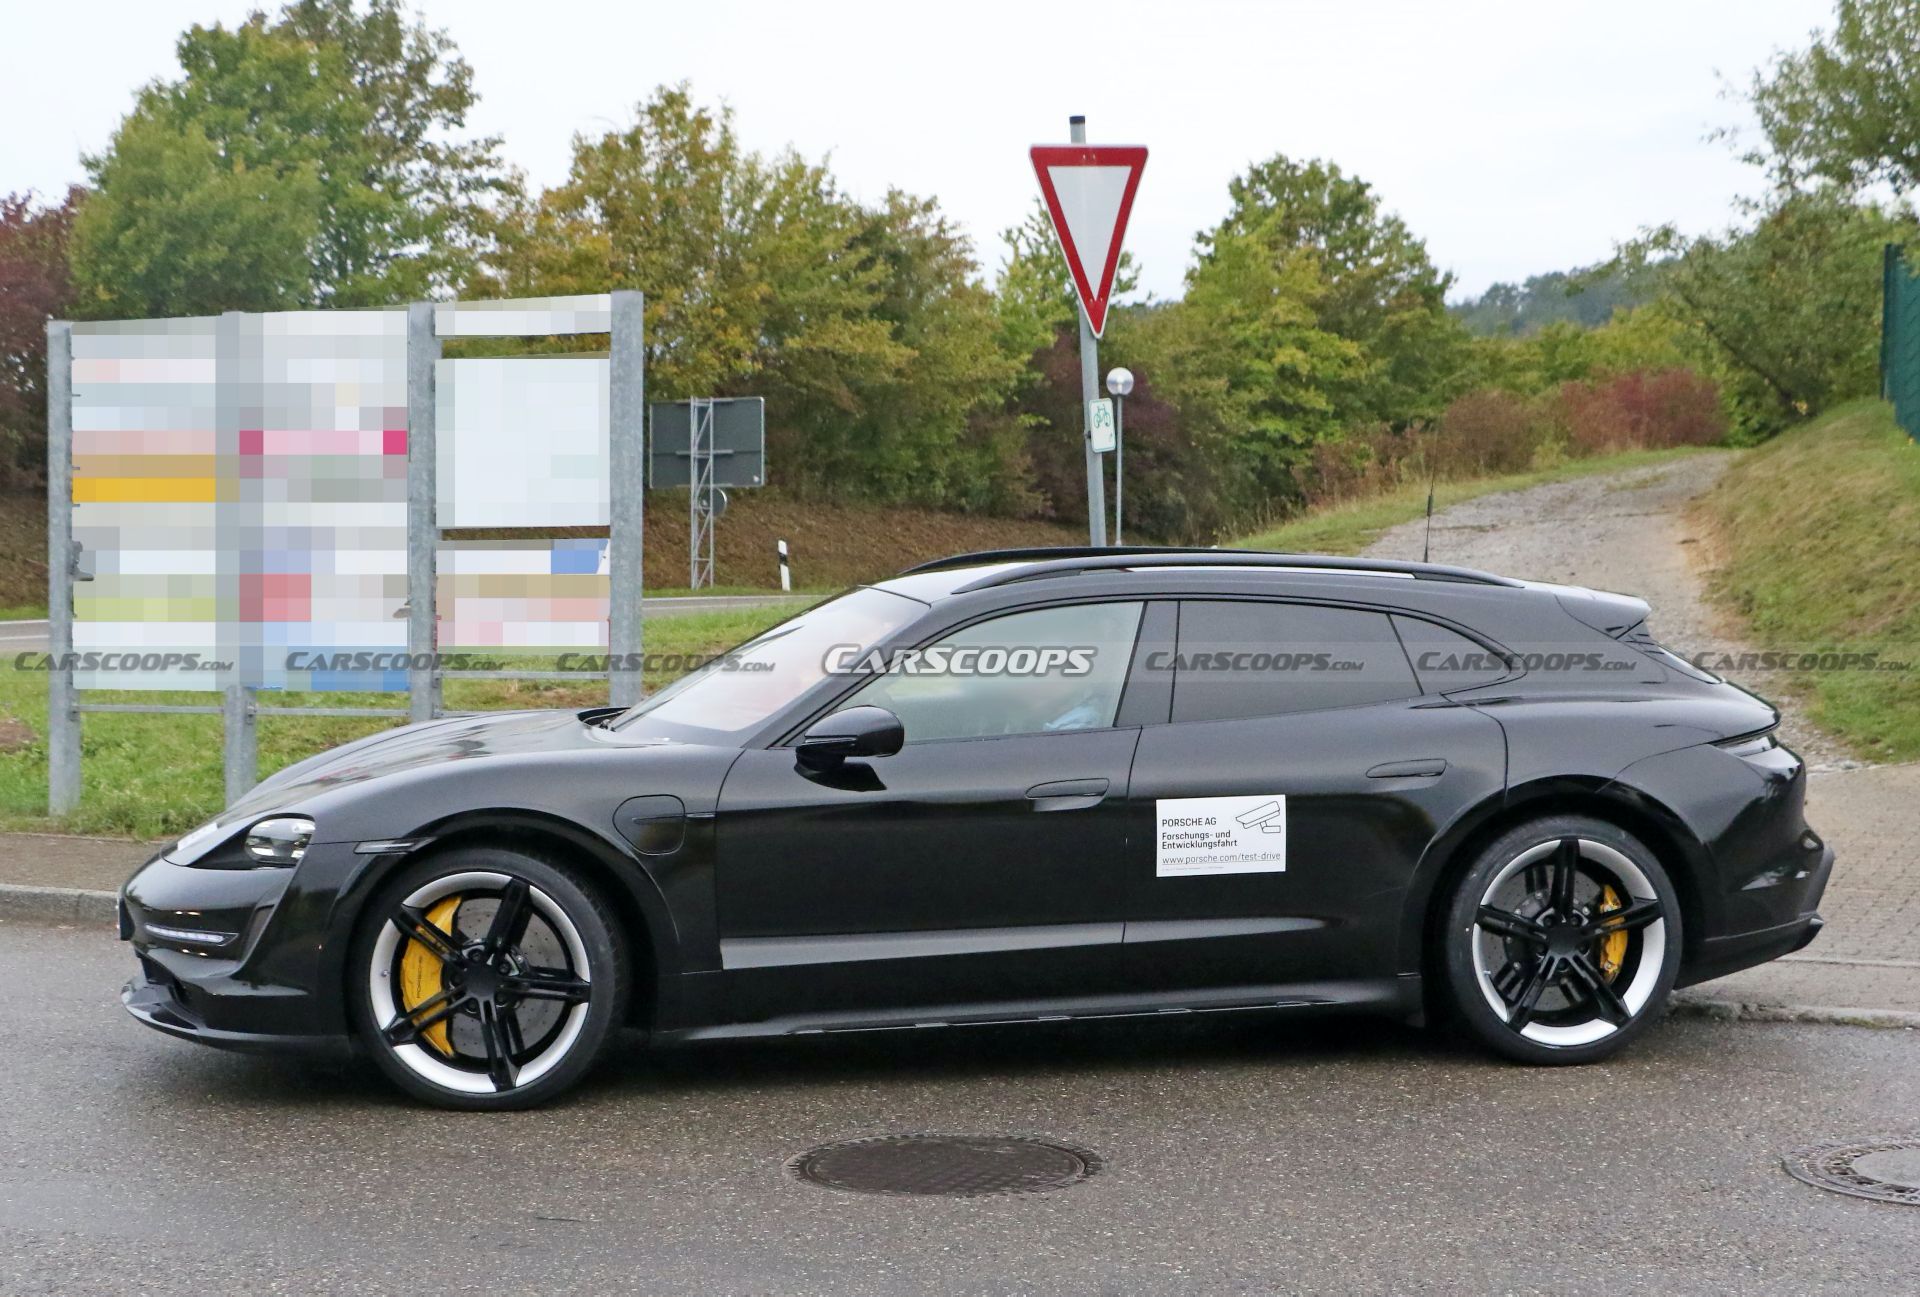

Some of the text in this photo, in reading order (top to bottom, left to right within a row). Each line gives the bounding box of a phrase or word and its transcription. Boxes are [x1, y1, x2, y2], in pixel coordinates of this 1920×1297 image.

[1162, 817, 1217, 827] PORSCHE AG
[1162, 830, 1231, 840] Forschungs- und
[1162, 840, 1237, 849] Entwicklungsfahrt
[1162, 852, 1281, 865] www.porsche.com/test-drive
